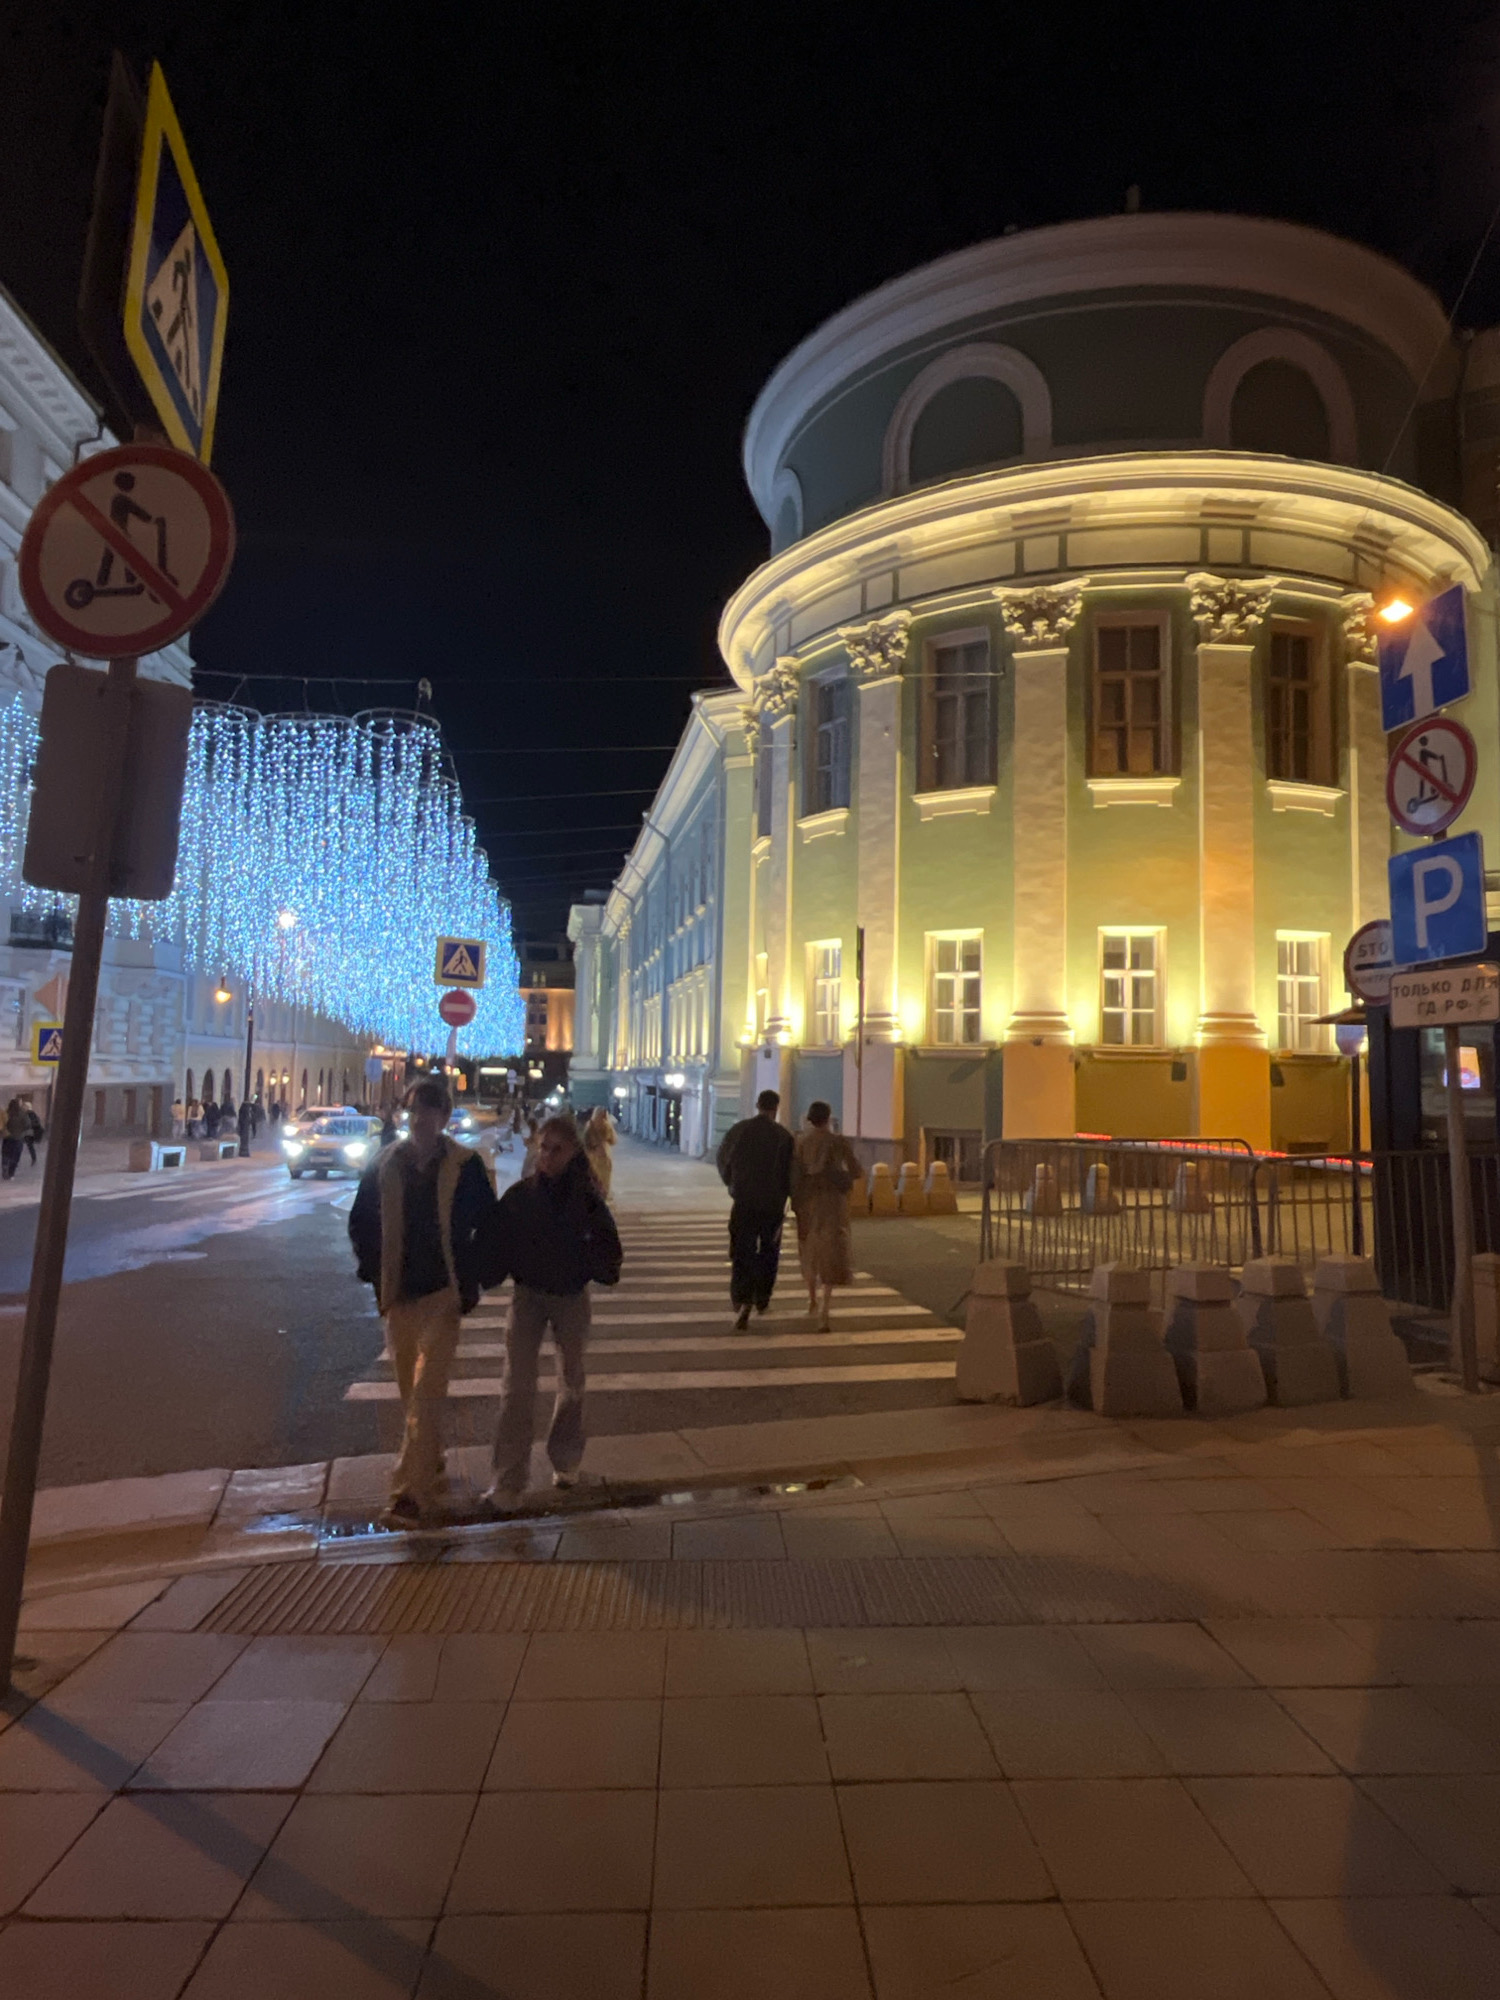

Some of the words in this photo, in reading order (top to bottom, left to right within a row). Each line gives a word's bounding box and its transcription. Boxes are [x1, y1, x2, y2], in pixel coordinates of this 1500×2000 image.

[1413, 855, 1463, 948] P
[1358, 942, 1389, 958] STO
[1393, 981, 1451, 998] ТОЛЬКО
[1461, 976, 1497, 992] ДЛЯ
